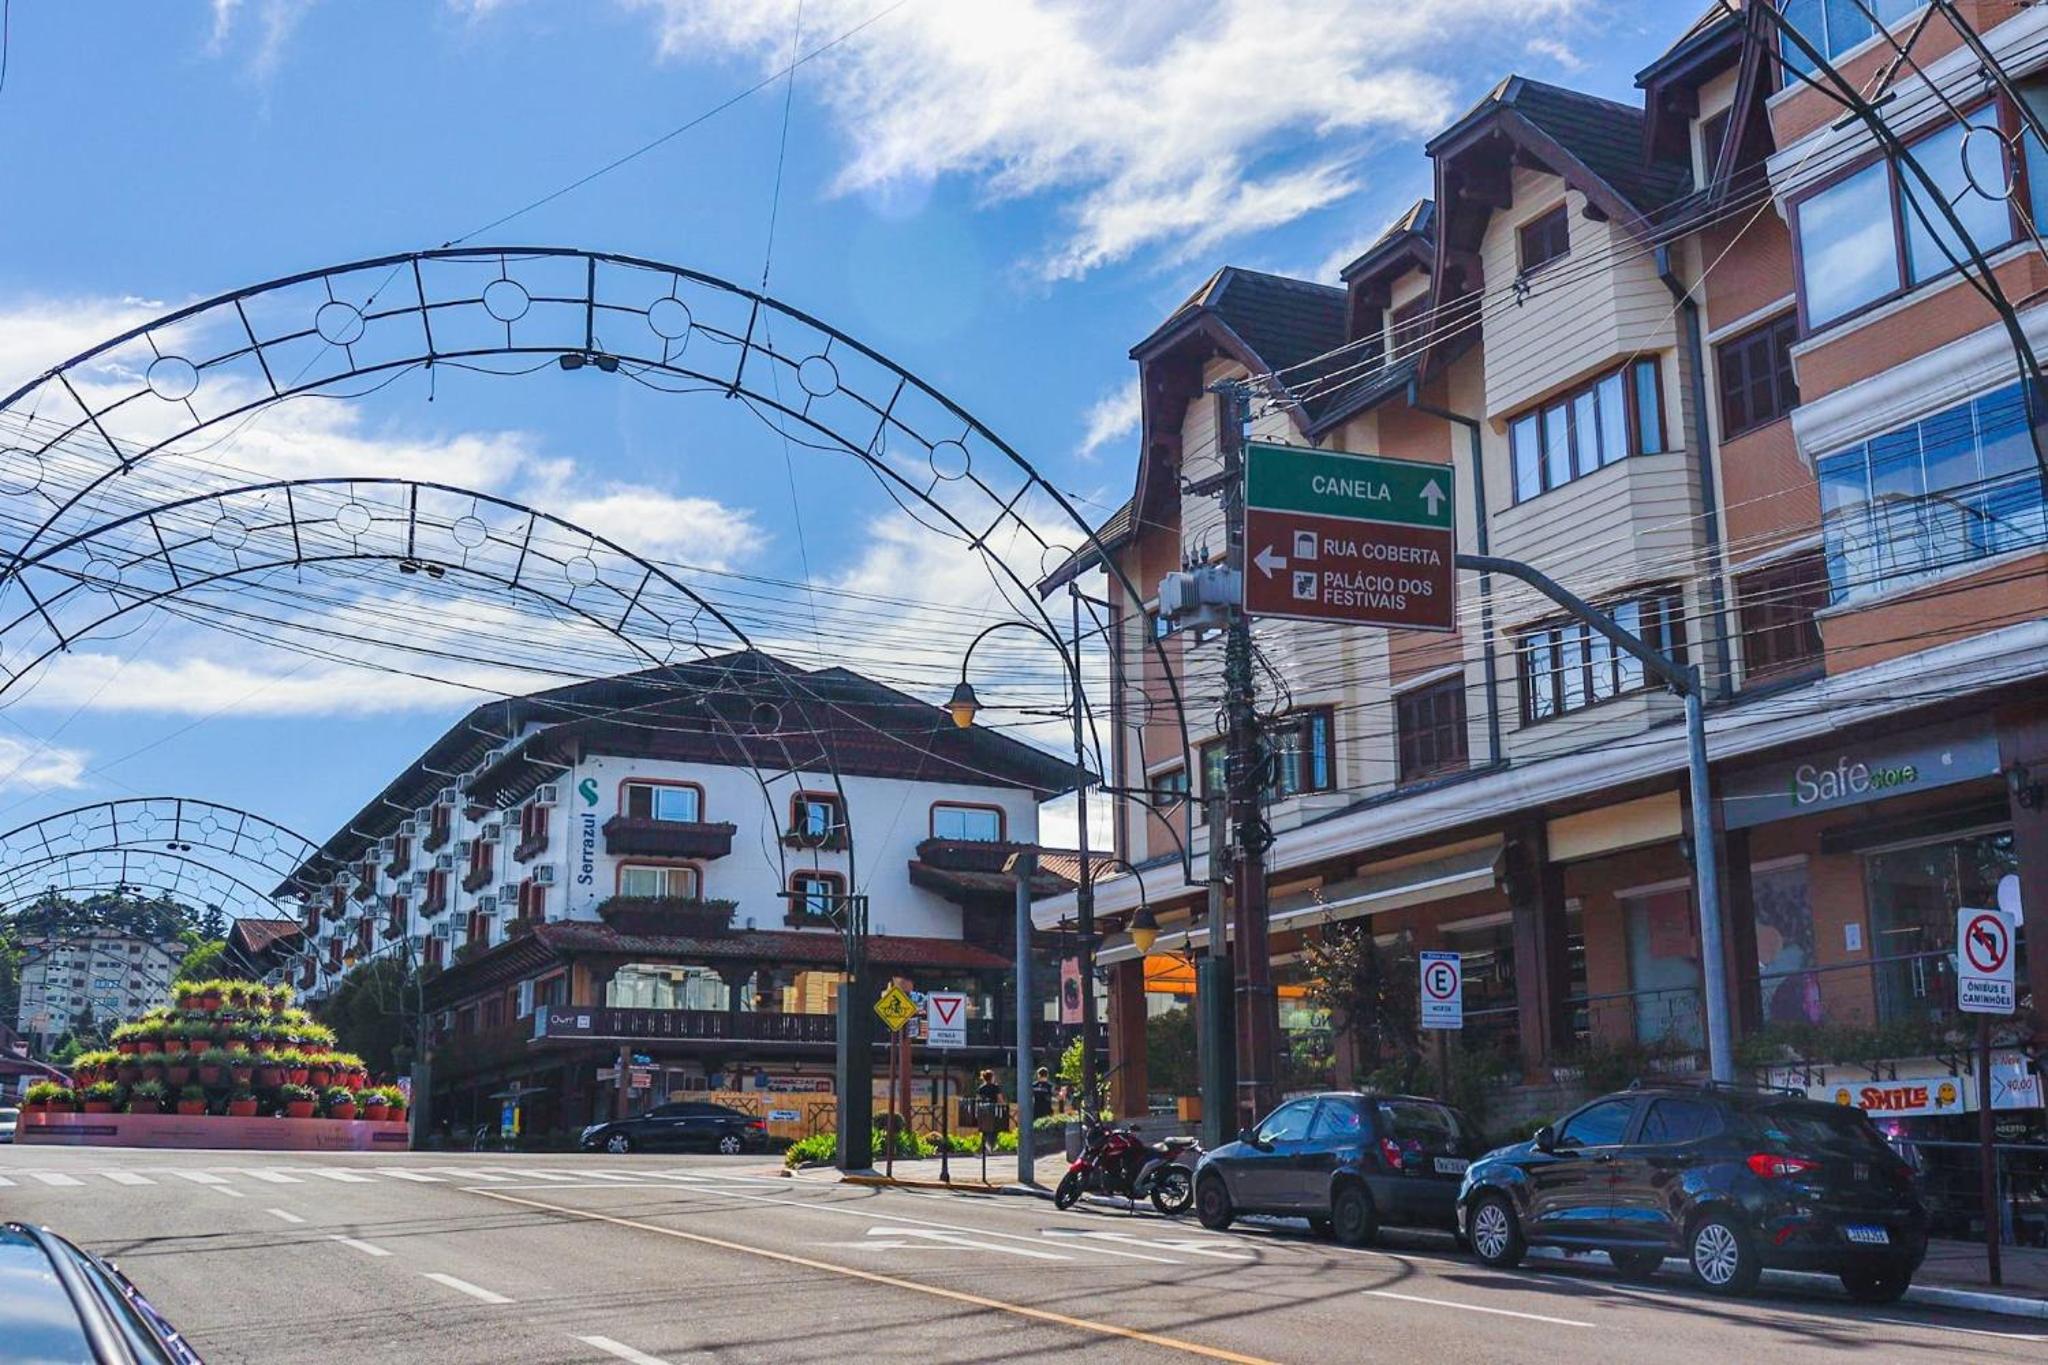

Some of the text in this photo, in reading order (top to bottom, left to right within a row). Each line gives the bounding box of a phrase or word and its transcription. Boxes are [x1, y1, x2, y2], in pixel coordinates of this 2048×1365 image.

[1312, 476, 1391, 501] CANELA
[1324, 539, 1440, 565] RUA COBERTA
[1323, 570, 1432, 596] PALÁCIO DOS
[1324, 590, 1406, 610] FESTIVAIS
[1795, 756, 1869, 804] Safe
[577, 813, 596, 885] Serrazul
[1435, 969, 1447, 992] E
[1967, 981, 2007, 994] ÔNIBUS E
[1962, 993, 2010, 1005] CAMINHÕES
